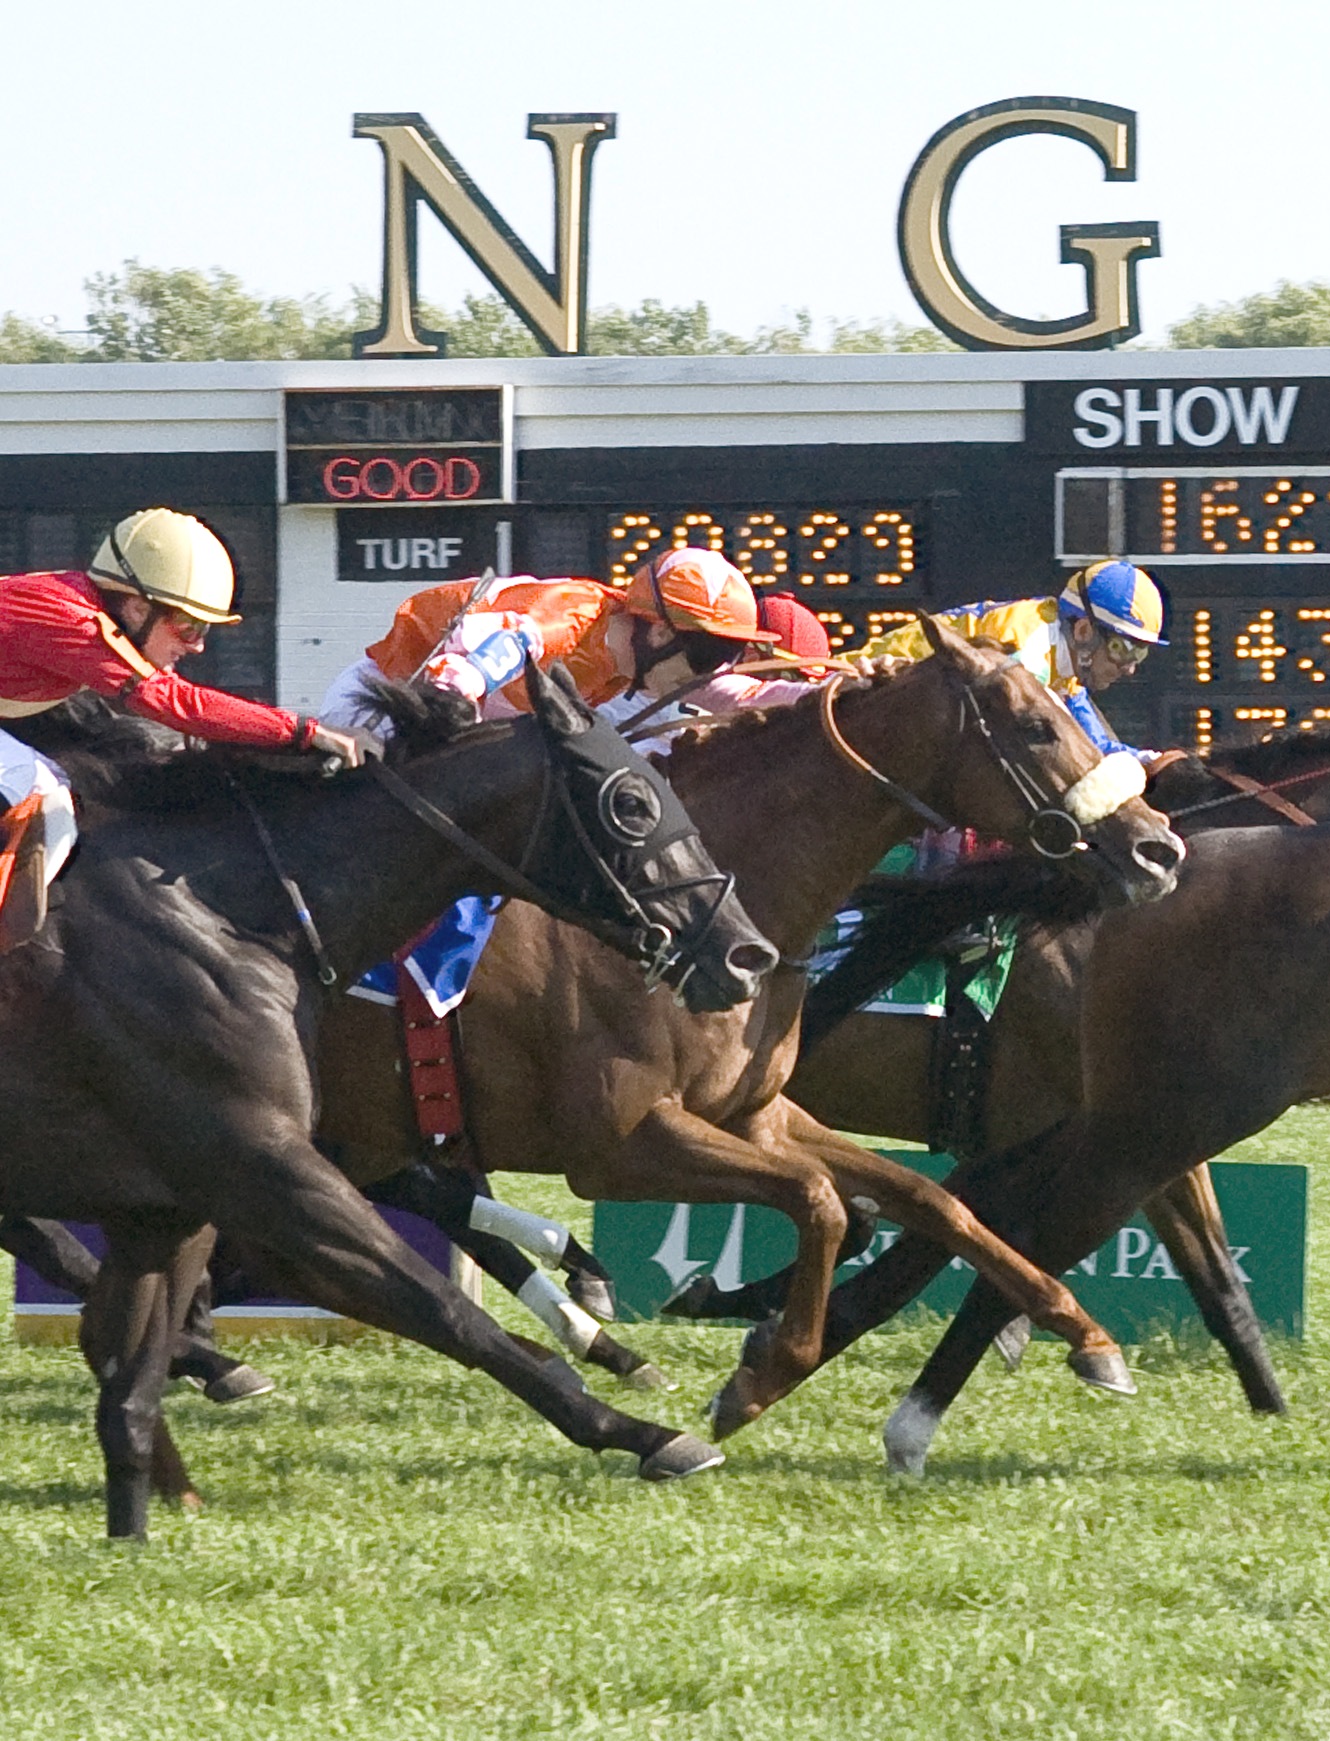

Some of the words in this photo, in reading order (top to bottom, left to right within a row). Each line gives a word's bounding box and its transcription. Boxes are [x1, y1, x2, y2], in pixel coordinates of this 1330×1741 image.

[1073, 385, 1299, 448] SHOW
[322, 456, 481, 500] GOOD
[356, 536, 464, 570] TURF
[1110, 1227, 1253, 1283] PAK
